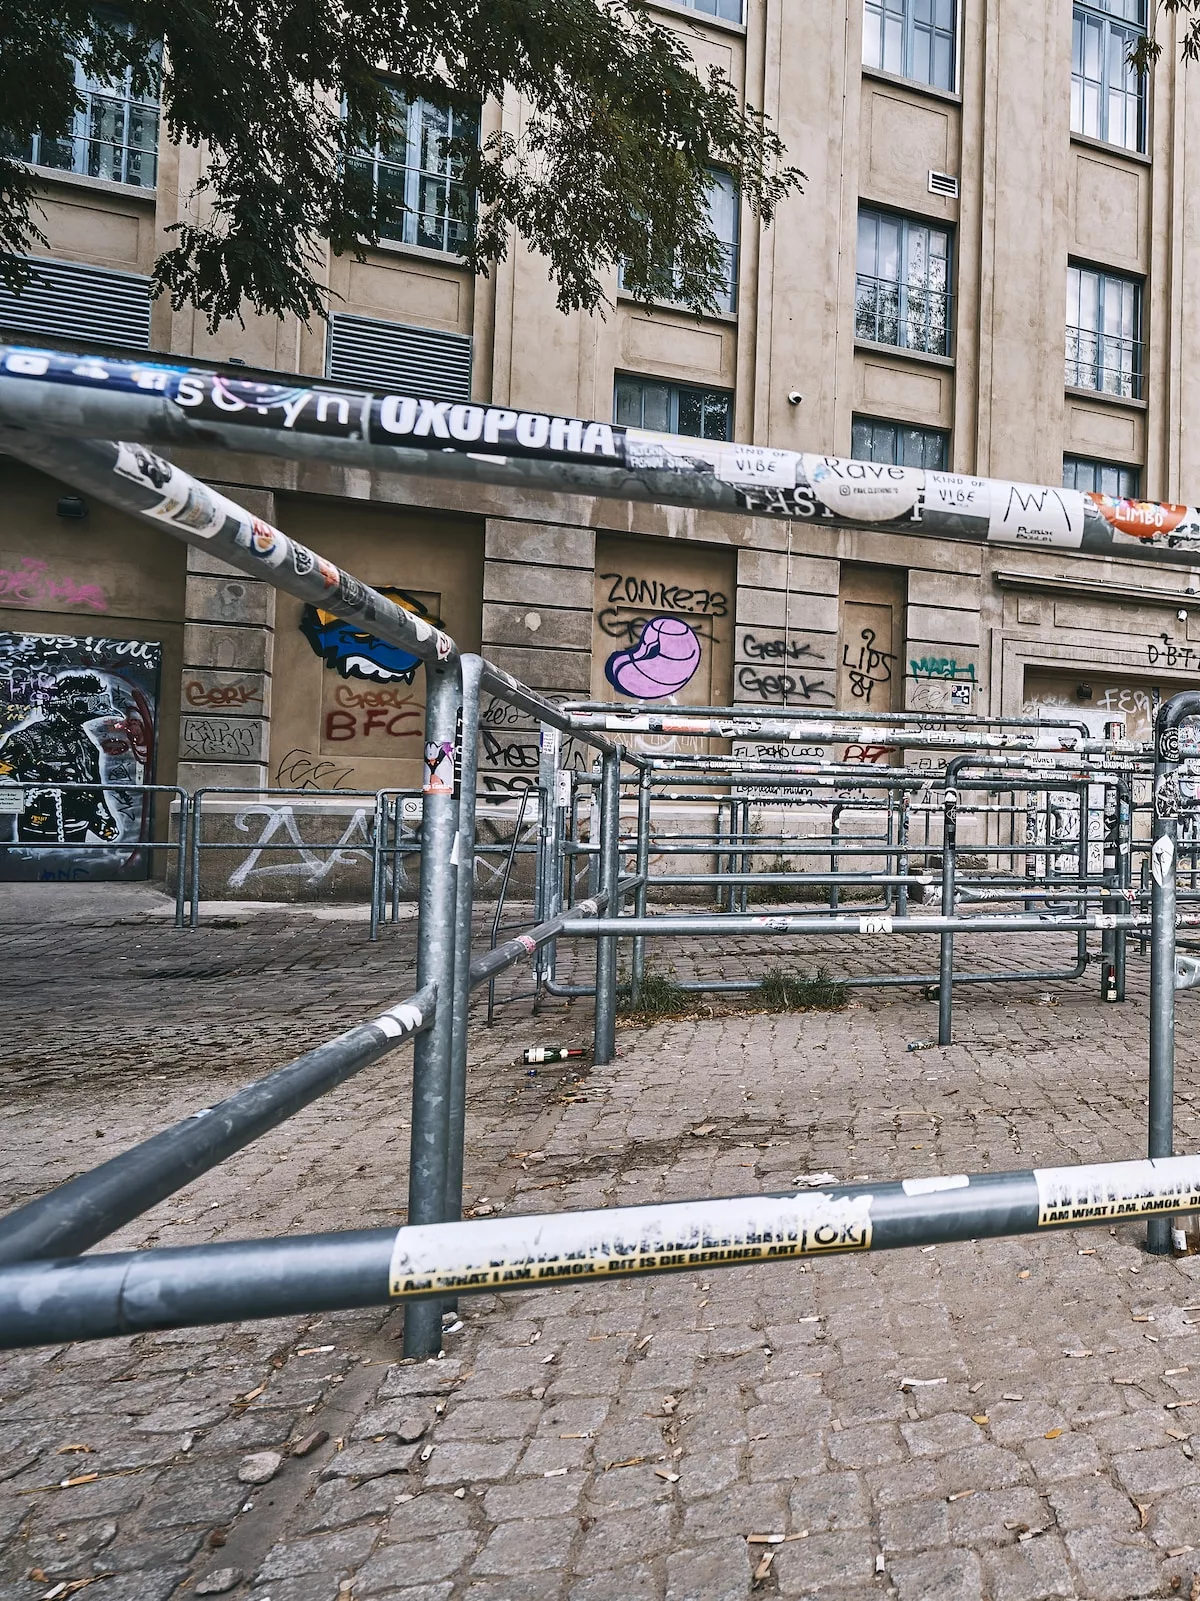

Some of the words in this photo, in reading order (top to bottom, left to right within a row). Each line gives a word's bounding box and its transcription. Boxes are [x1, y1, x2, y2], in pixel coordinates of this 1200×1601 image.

[380, 396, 616, 456] ОХОРОНА
[736, 460, 777, 473] VIBE
[939, 489, 976, 502] VIBE
[1115, 505, 1163, 527] LIMBO
[1050, 1210, 1070, 1221] AM
[1072, 1206, 1107, 1218] WHAT
[1117, 1203, 1139, 1214] AM.
[404, 1279, 432, 1291] AM
[437, 1272, 489, 1287] WHAT
[502, 1268, 535, 1281] AM.
[608, 1259, 636, 1271] DIT
[640, 1256, 657, 1267] IS
[659, 1254, 686, 1266] DIE
[689, 1247, 762, 1263] BERLINER
[768, 1244, 797, 1256] ART
